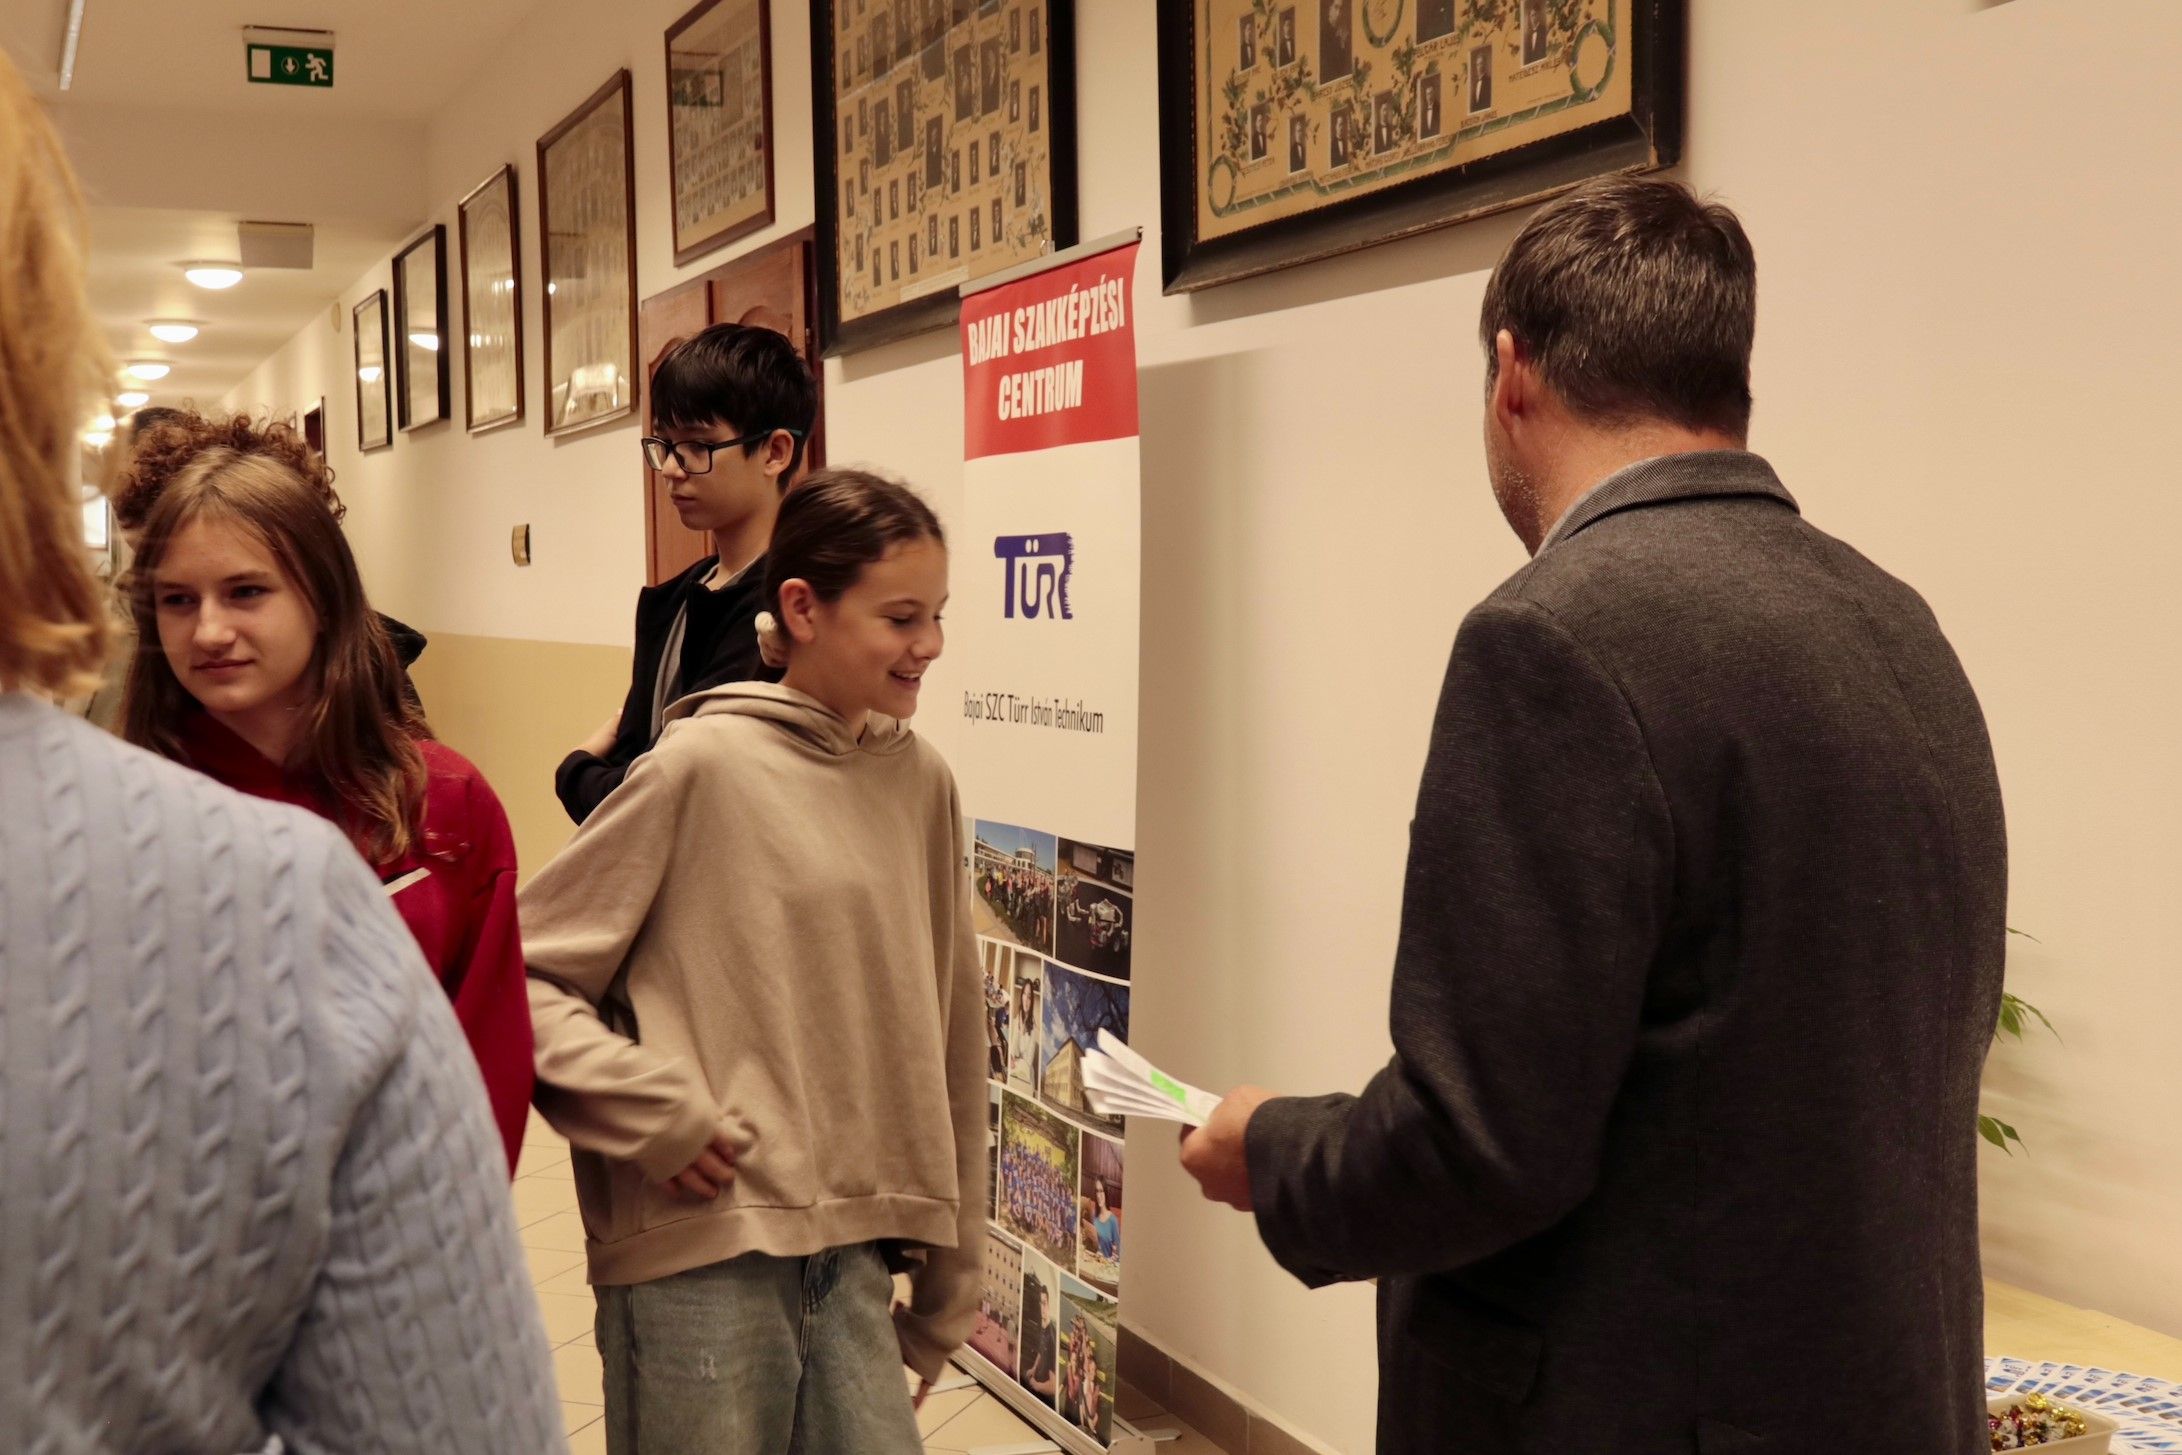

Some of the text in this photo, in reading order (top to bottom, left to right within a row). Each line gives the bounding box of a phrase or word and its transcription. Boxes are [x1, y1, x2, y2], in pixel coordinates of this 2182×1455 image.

[967, 274, 1125, 366] BAJAI SZAKKÉPZÉSI
[998, 360, 1083, 421] CENTRUM
[964, 691, 1104, 733] Bajai SZC Türr István Technikum
